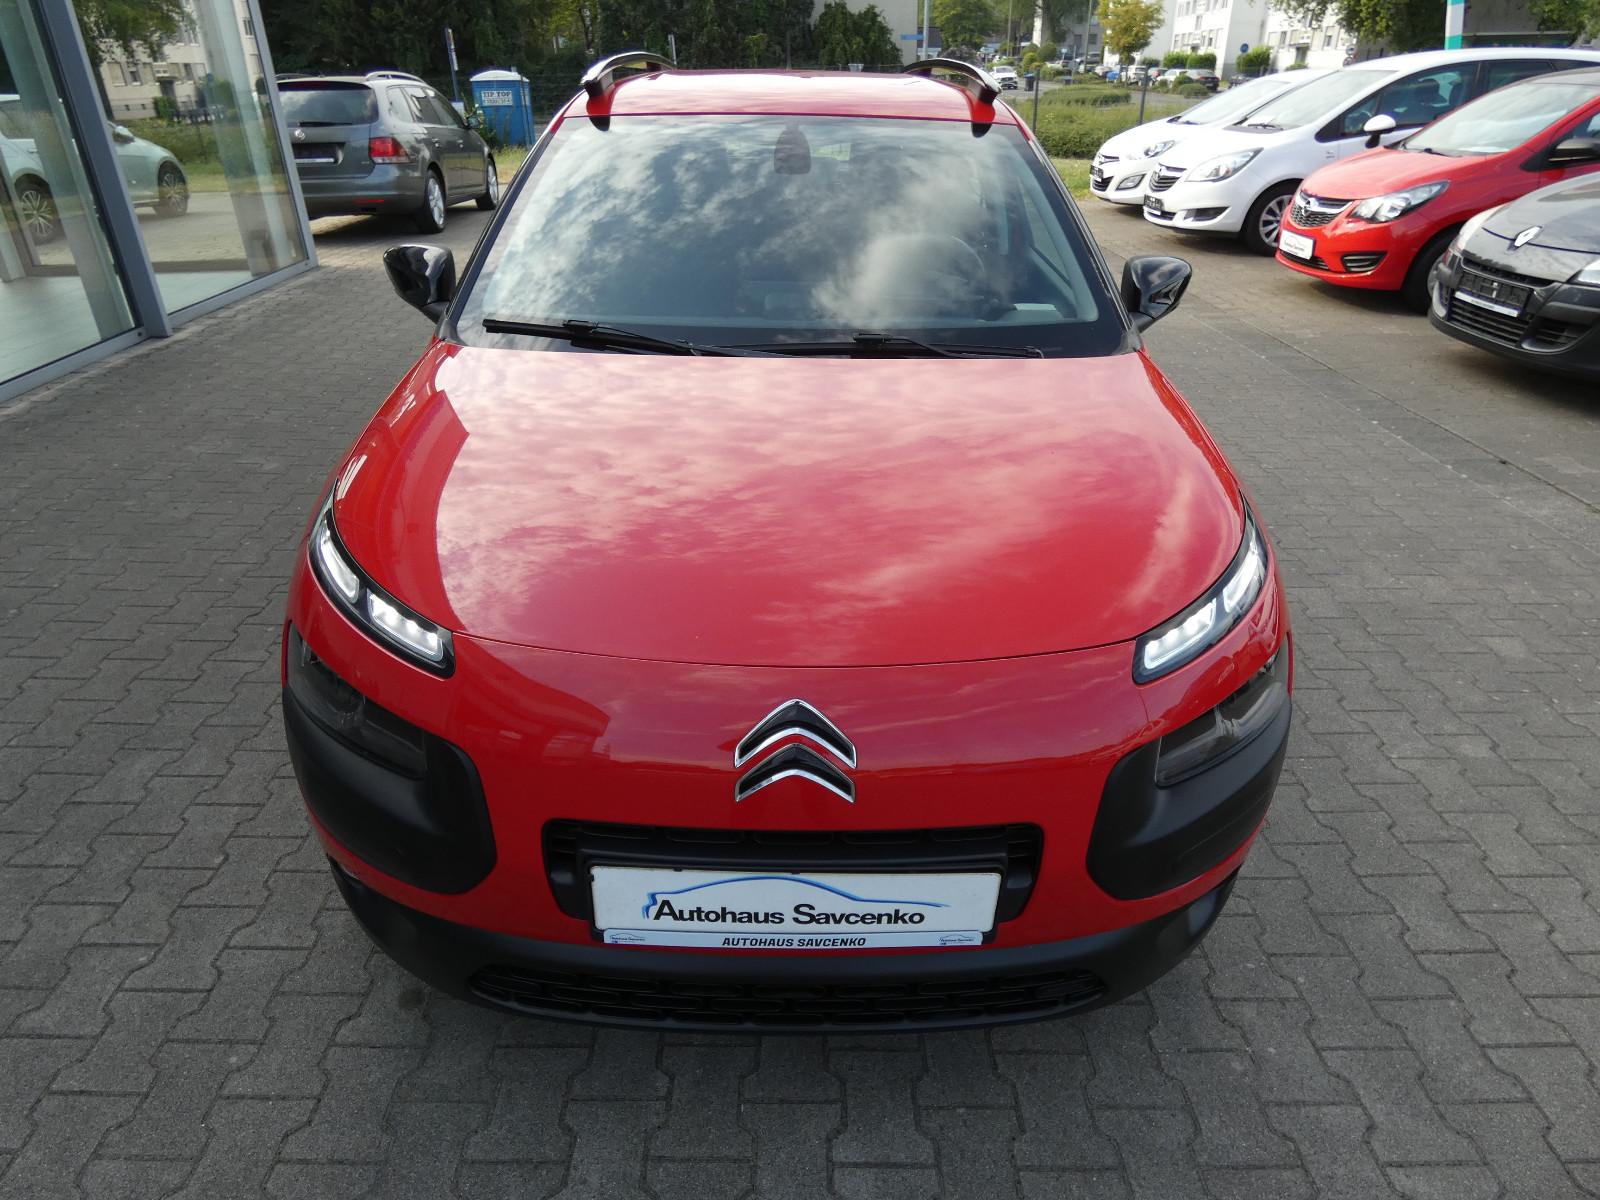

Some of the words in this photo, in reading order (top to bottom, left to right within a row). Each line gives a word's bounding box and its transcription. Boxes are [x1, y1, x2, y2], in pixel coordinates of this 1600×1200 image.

[653, 899, 785, 924] Autohaus
[792, 903, 925, 925] Savcenko
[722, 937, 794, 947] AUTOHAUS
[797, 937, 867, 947] SAVCENKO
